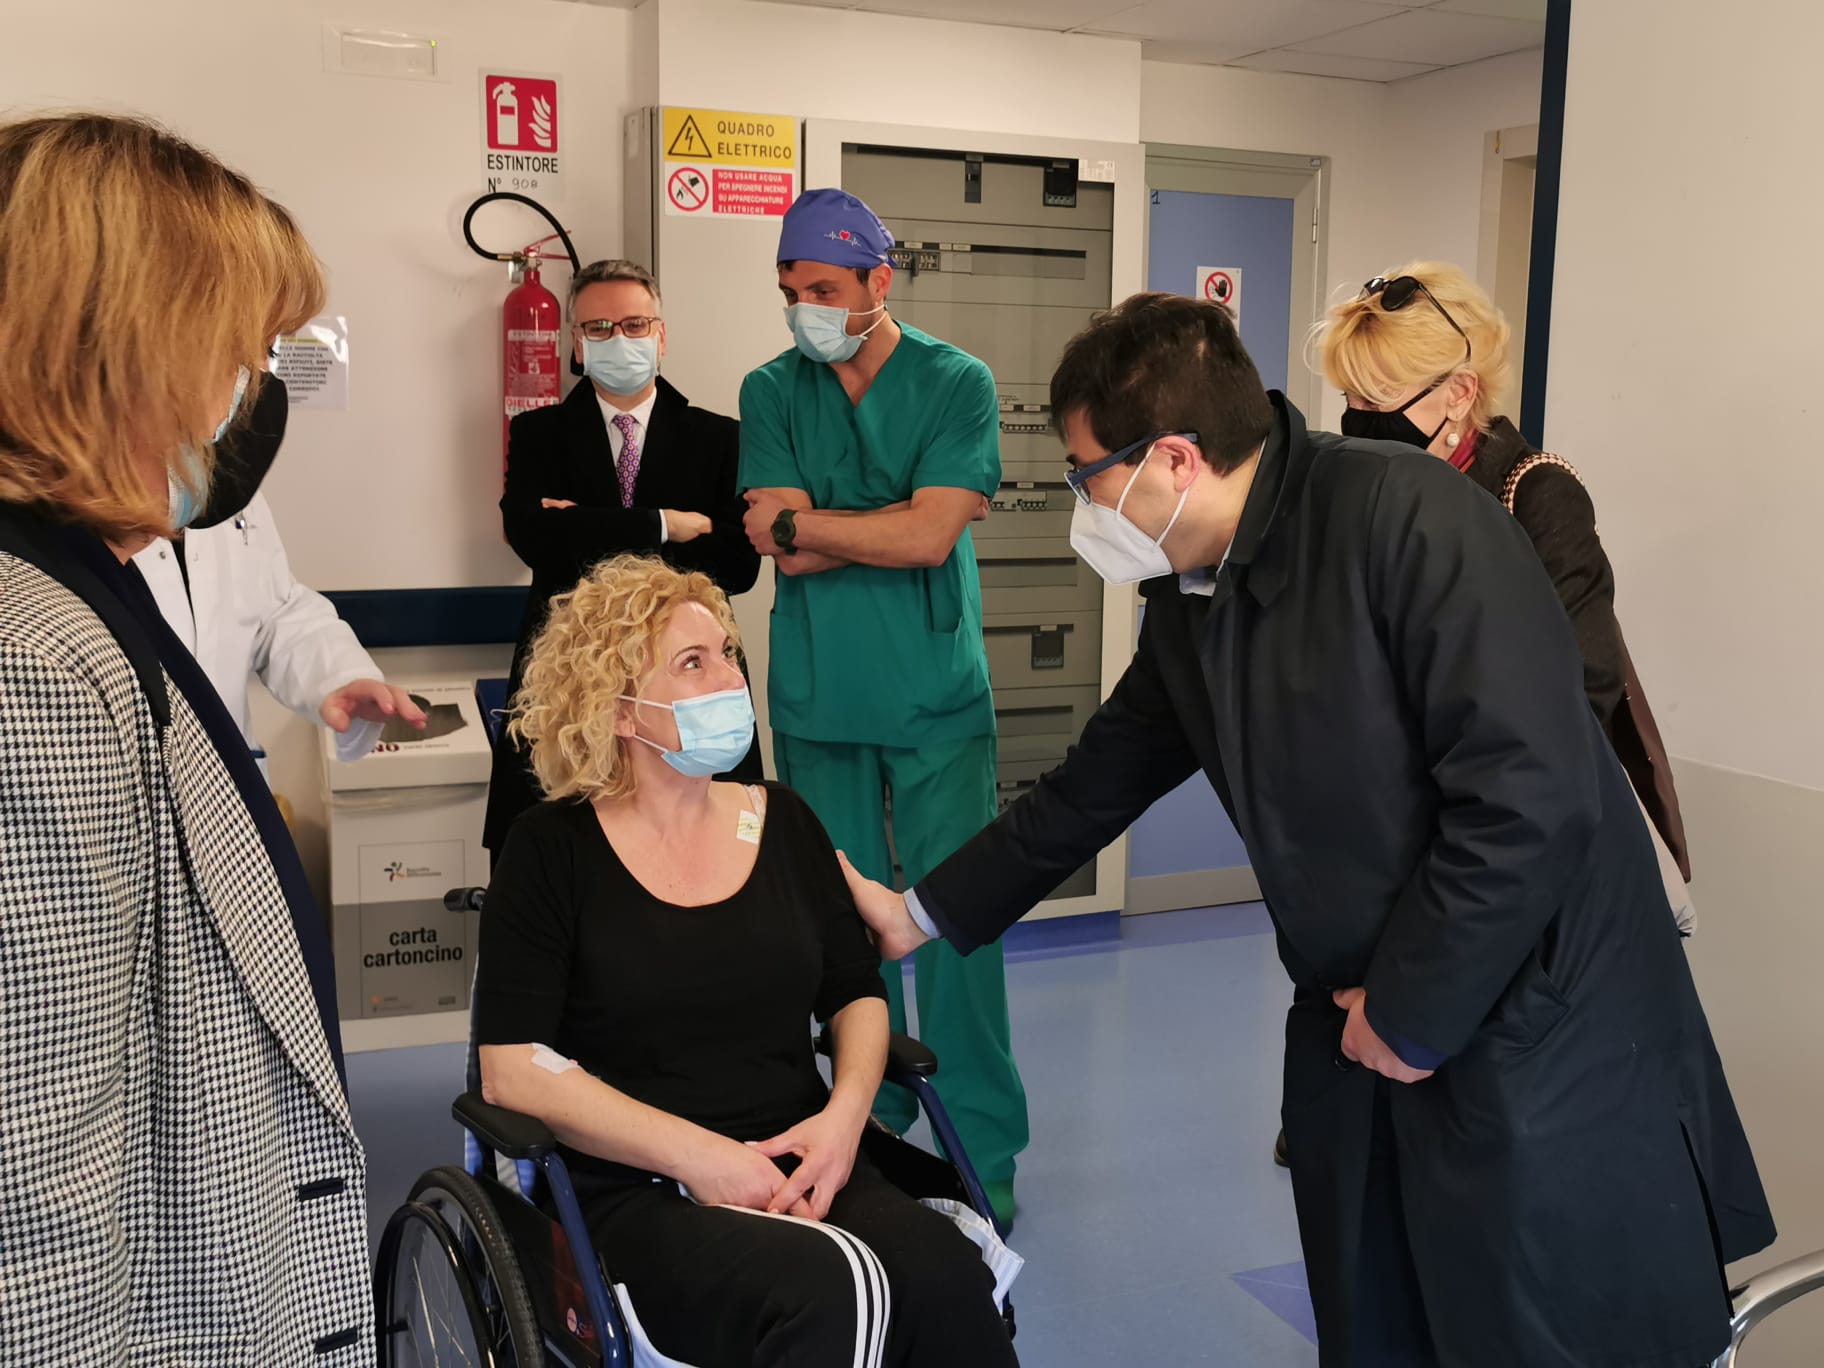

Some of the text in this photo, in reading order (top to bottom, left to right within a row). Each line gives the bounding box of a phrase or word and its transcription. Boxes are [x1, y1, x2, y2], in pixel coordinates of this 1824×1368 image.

[717, 120, 775, 137] QUADRO
[717, 142, 792, 159] ELETTRICO
[487, 154, 559, 173] ESTINTORE
[718, 171, 783, 183] NON USARE ACQUA
[718, 182, 788, 194] PER SPEGNERE INCENDI
[718, 204, 765, 214] ELETTRICHE
[389, 926, 437, 946] carta
[363, 945, 464, 968] cartoncino
